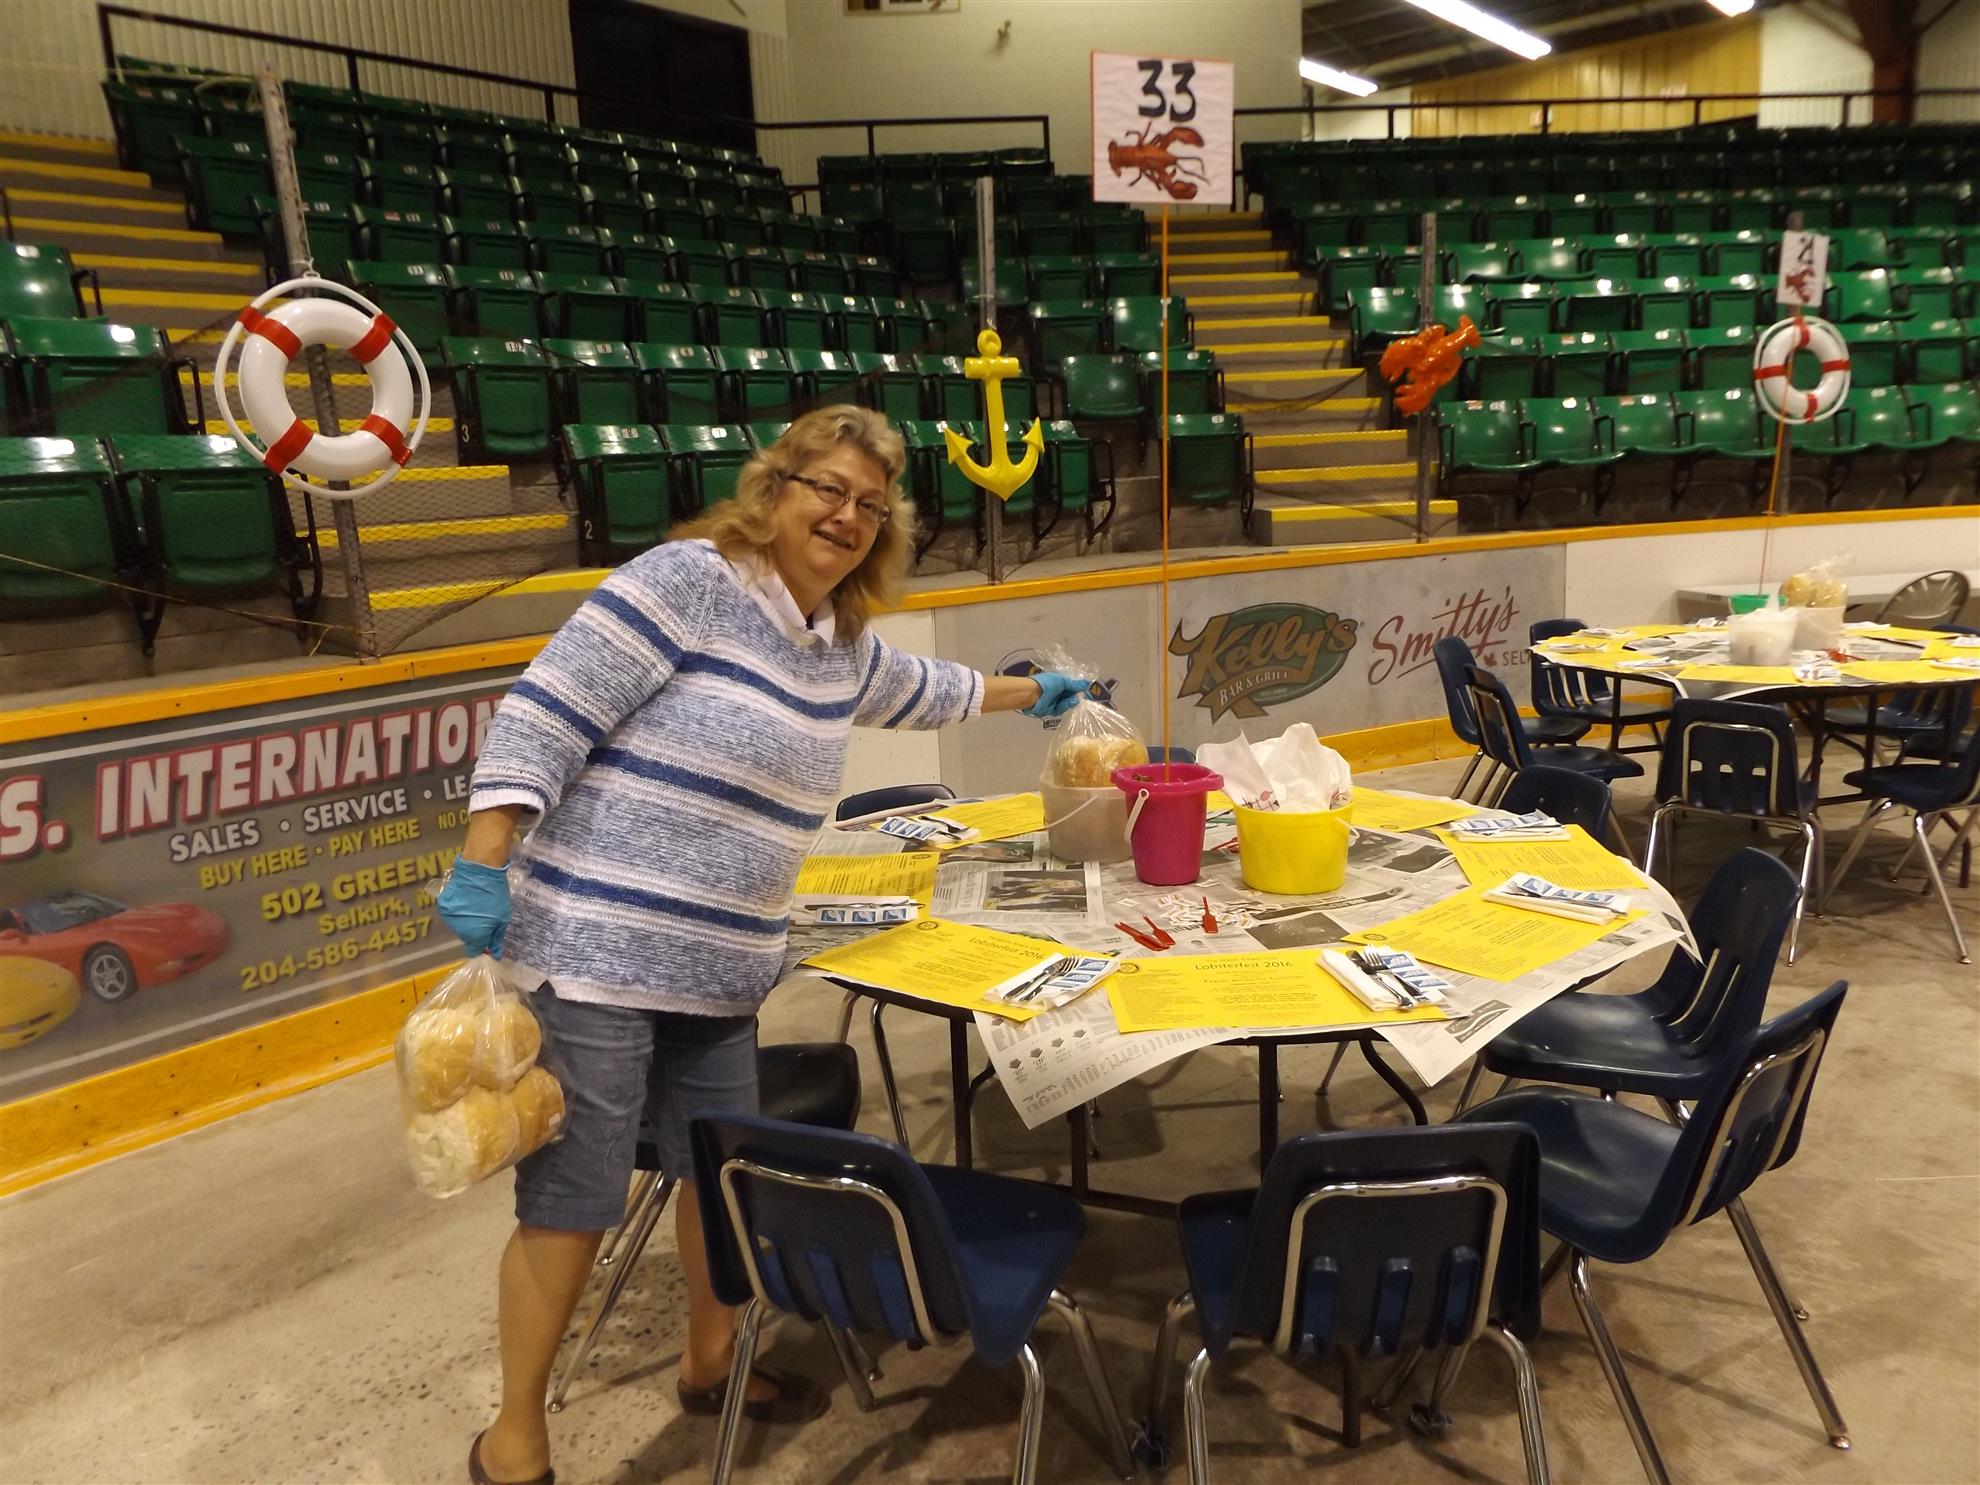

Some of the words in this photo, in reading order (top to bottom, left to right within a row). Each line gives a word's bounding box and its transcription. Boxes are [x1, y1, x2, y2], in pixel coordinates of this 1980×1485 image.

[1138, 60, 1196, 122] 33
[461, 424, 470, 443] 3
[1168, 613, 1358, 698] Kelly's
[1368, 586, 1519, 685] Smitty's
[1219, 681, 1244, 706] BAR
[1246, 678, 1254, 689] &
[170, 820, 260, 862] SALES
[304, 788, 408, 833] SERVICE
[443, 774, 470, 801] LE
[201, 860, 246, 890] BUY
[252, 845, 308, 878] HERE
[329, 831, 367, 858] PAY
[370, 819, 420, 849] HERE
[438, 813, 456, 830] NO
[261, 882, 323, 920] 502
[318, 897, 412, 935] Selkirk,
[241, 915, 432, 991] 204-586-4457
[1195, 961, 1259, 971] Lobsterfest
[1263, 960, 1293, 969] 2016
